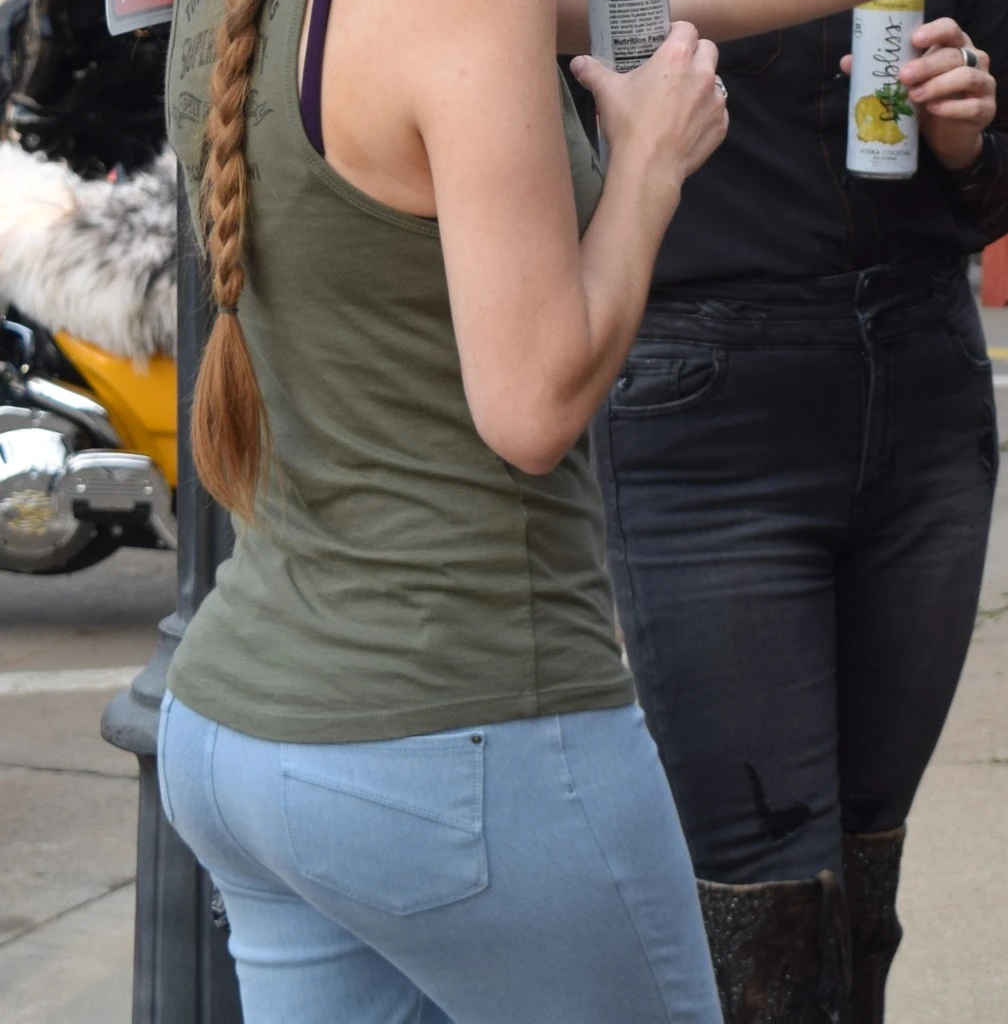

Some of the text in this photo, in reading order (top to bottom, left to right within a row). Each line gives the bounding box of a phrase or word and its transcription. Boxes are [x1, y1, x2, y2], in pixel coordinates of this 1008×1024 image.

[613, 34, 665, 46] Nutrition Facts
[615, 63, 641, 72] Calorie
